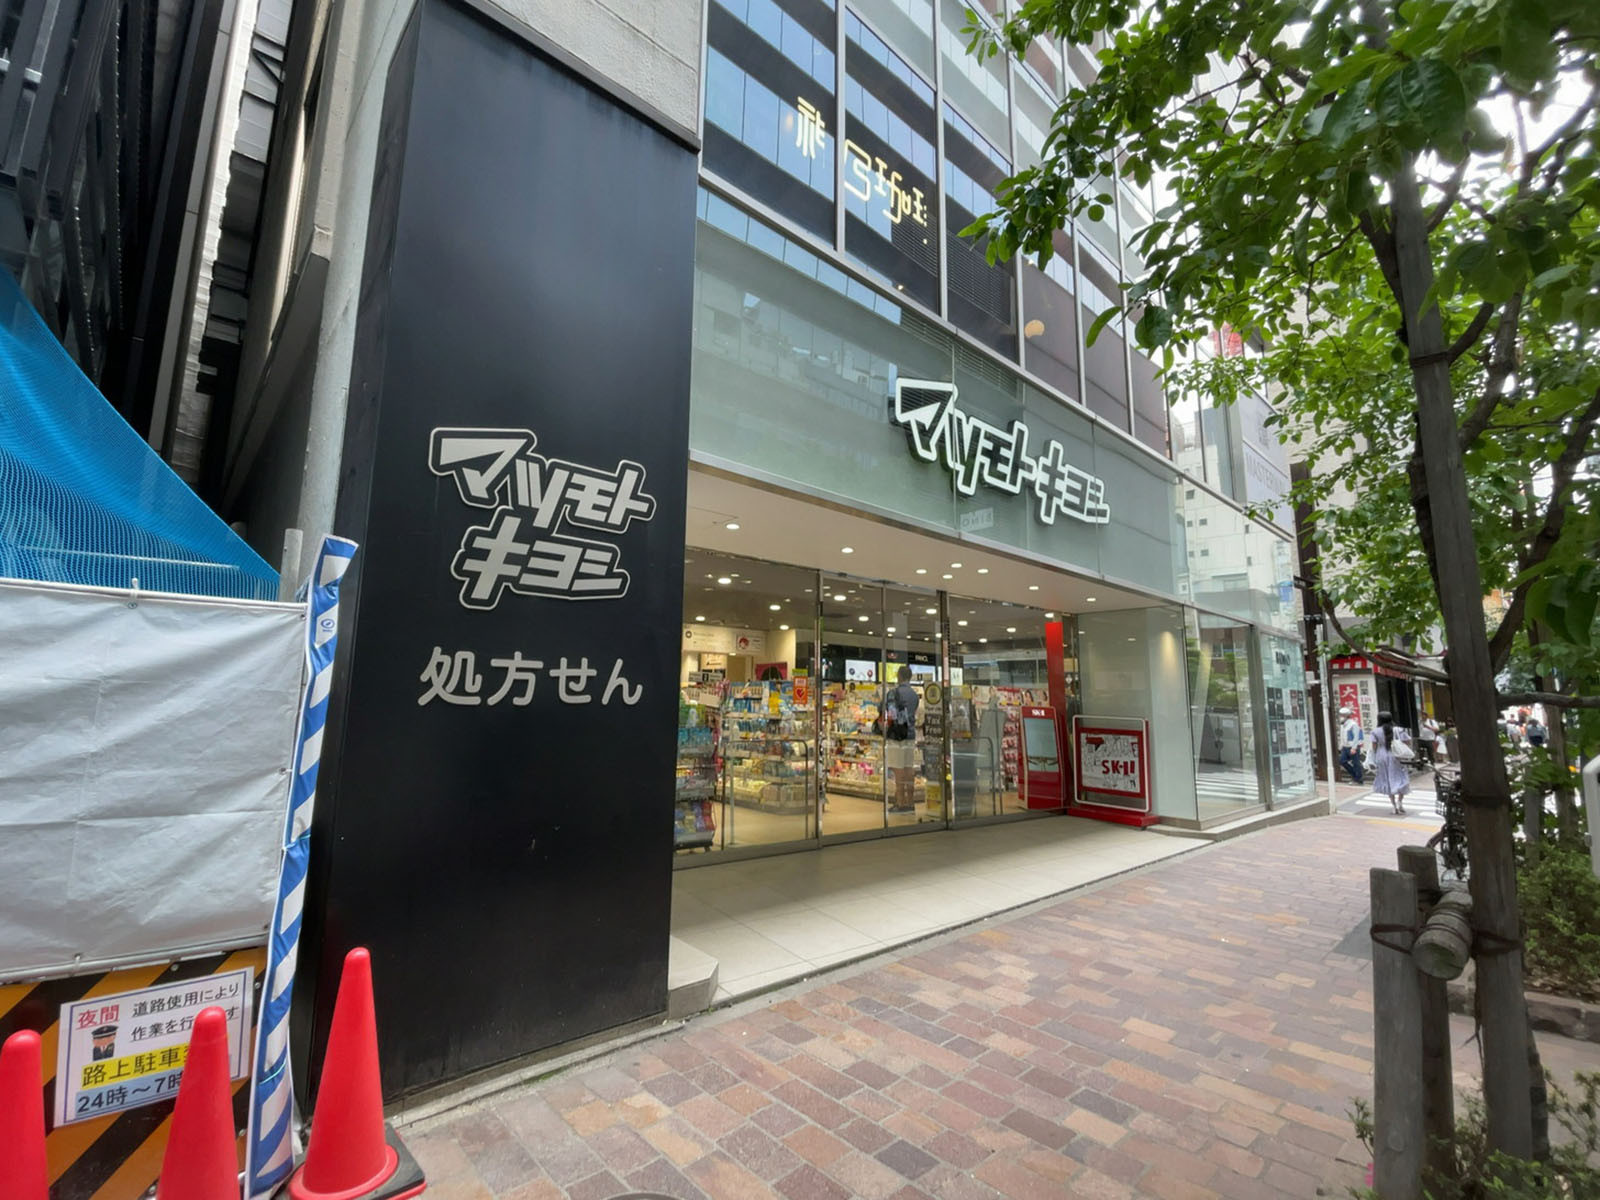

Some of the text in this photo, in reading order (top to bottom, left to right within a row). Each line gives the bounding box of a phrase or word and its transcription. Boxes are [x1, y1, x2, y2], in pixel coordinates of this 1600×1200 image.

[432, 430, 655, 532] マツモト
[896, 377, 1110, 525] マツモトキヨシ
[454, 513, 628, 606] キヨシ
[418, 646, 643, 706] 処方せん
[77, 983, 239, 1029] 夜間 道路使用により
[131, 1005, 240, 1041] 作業を行す
[82, 1045, 190, 1088] 路上駐車
